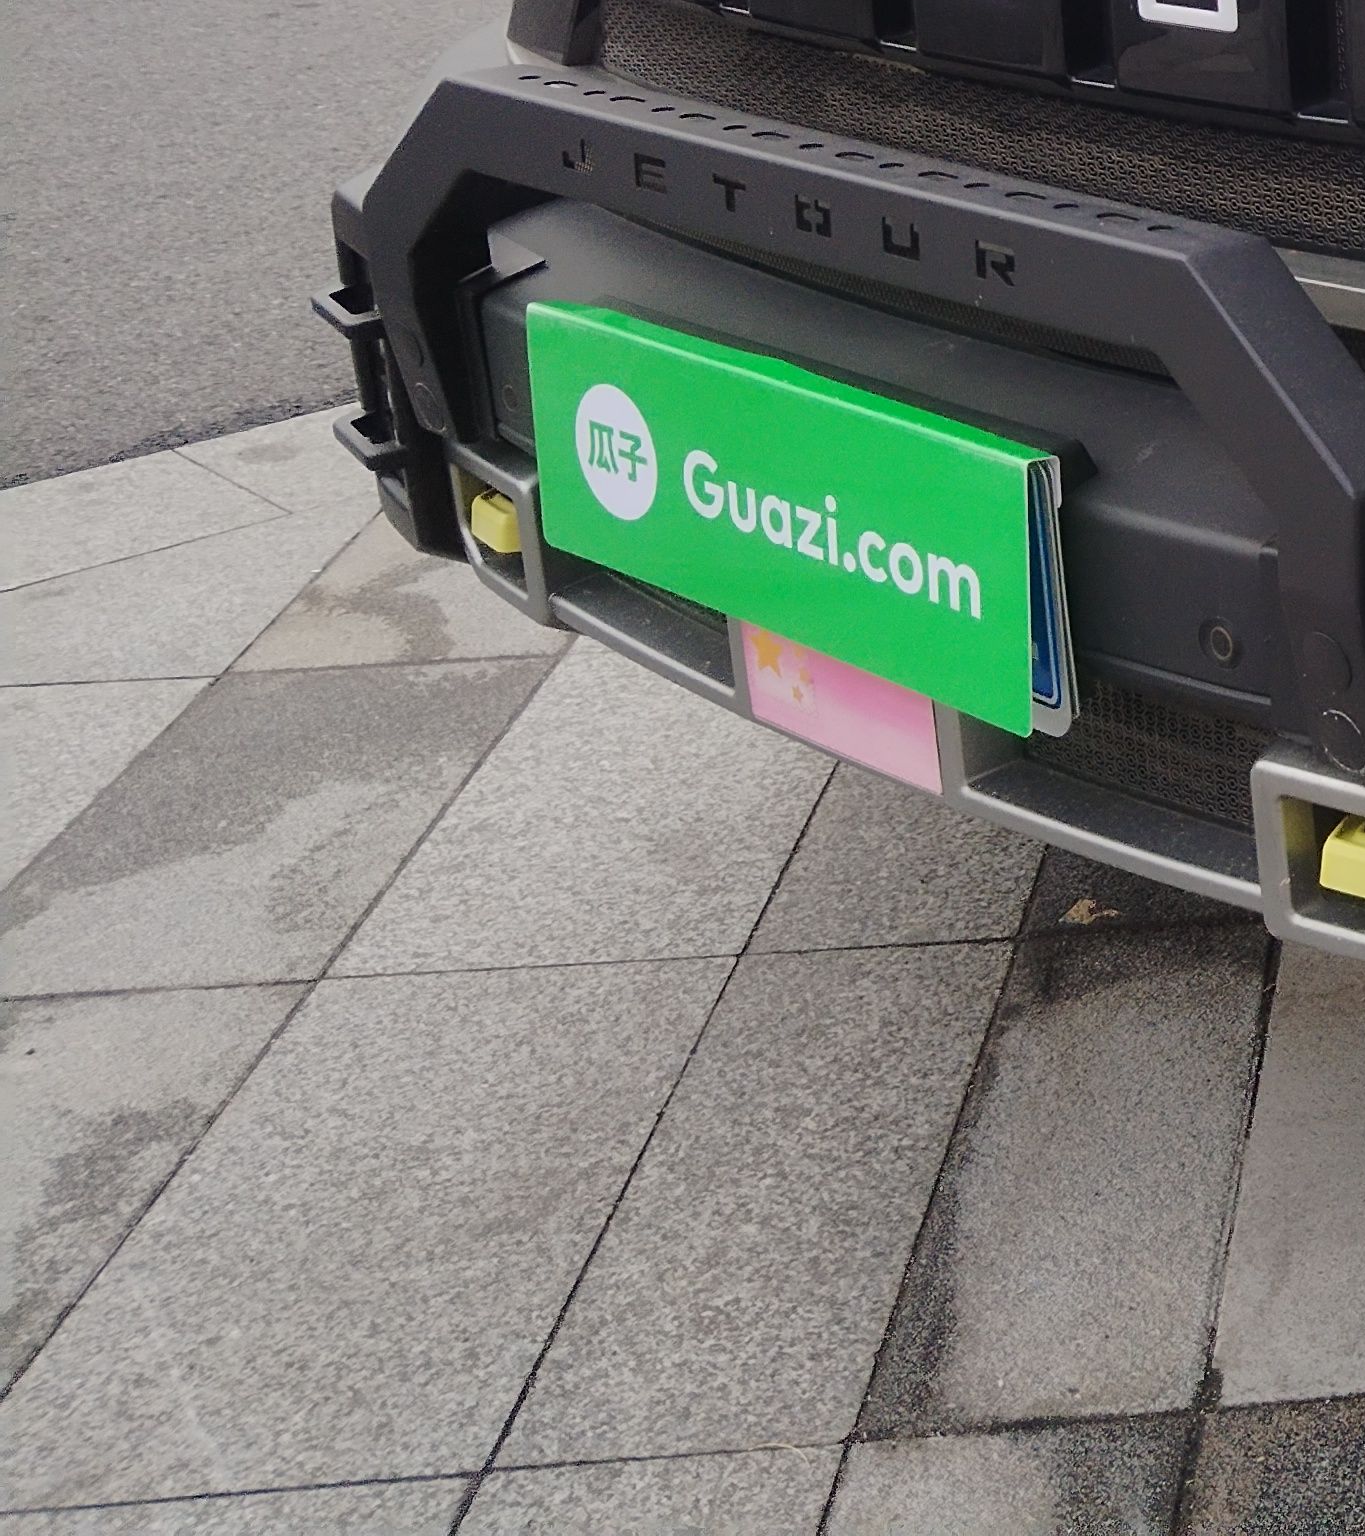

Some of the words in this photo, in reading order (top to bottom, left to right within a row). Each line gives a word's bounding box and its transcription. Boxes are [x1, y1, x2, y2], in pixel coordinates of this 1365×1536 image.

[562, 138, 1016, 286] JETOUR
[588, 419, 648, 483] 瓜子
[682, 448, 982, 620] Guazi.com
